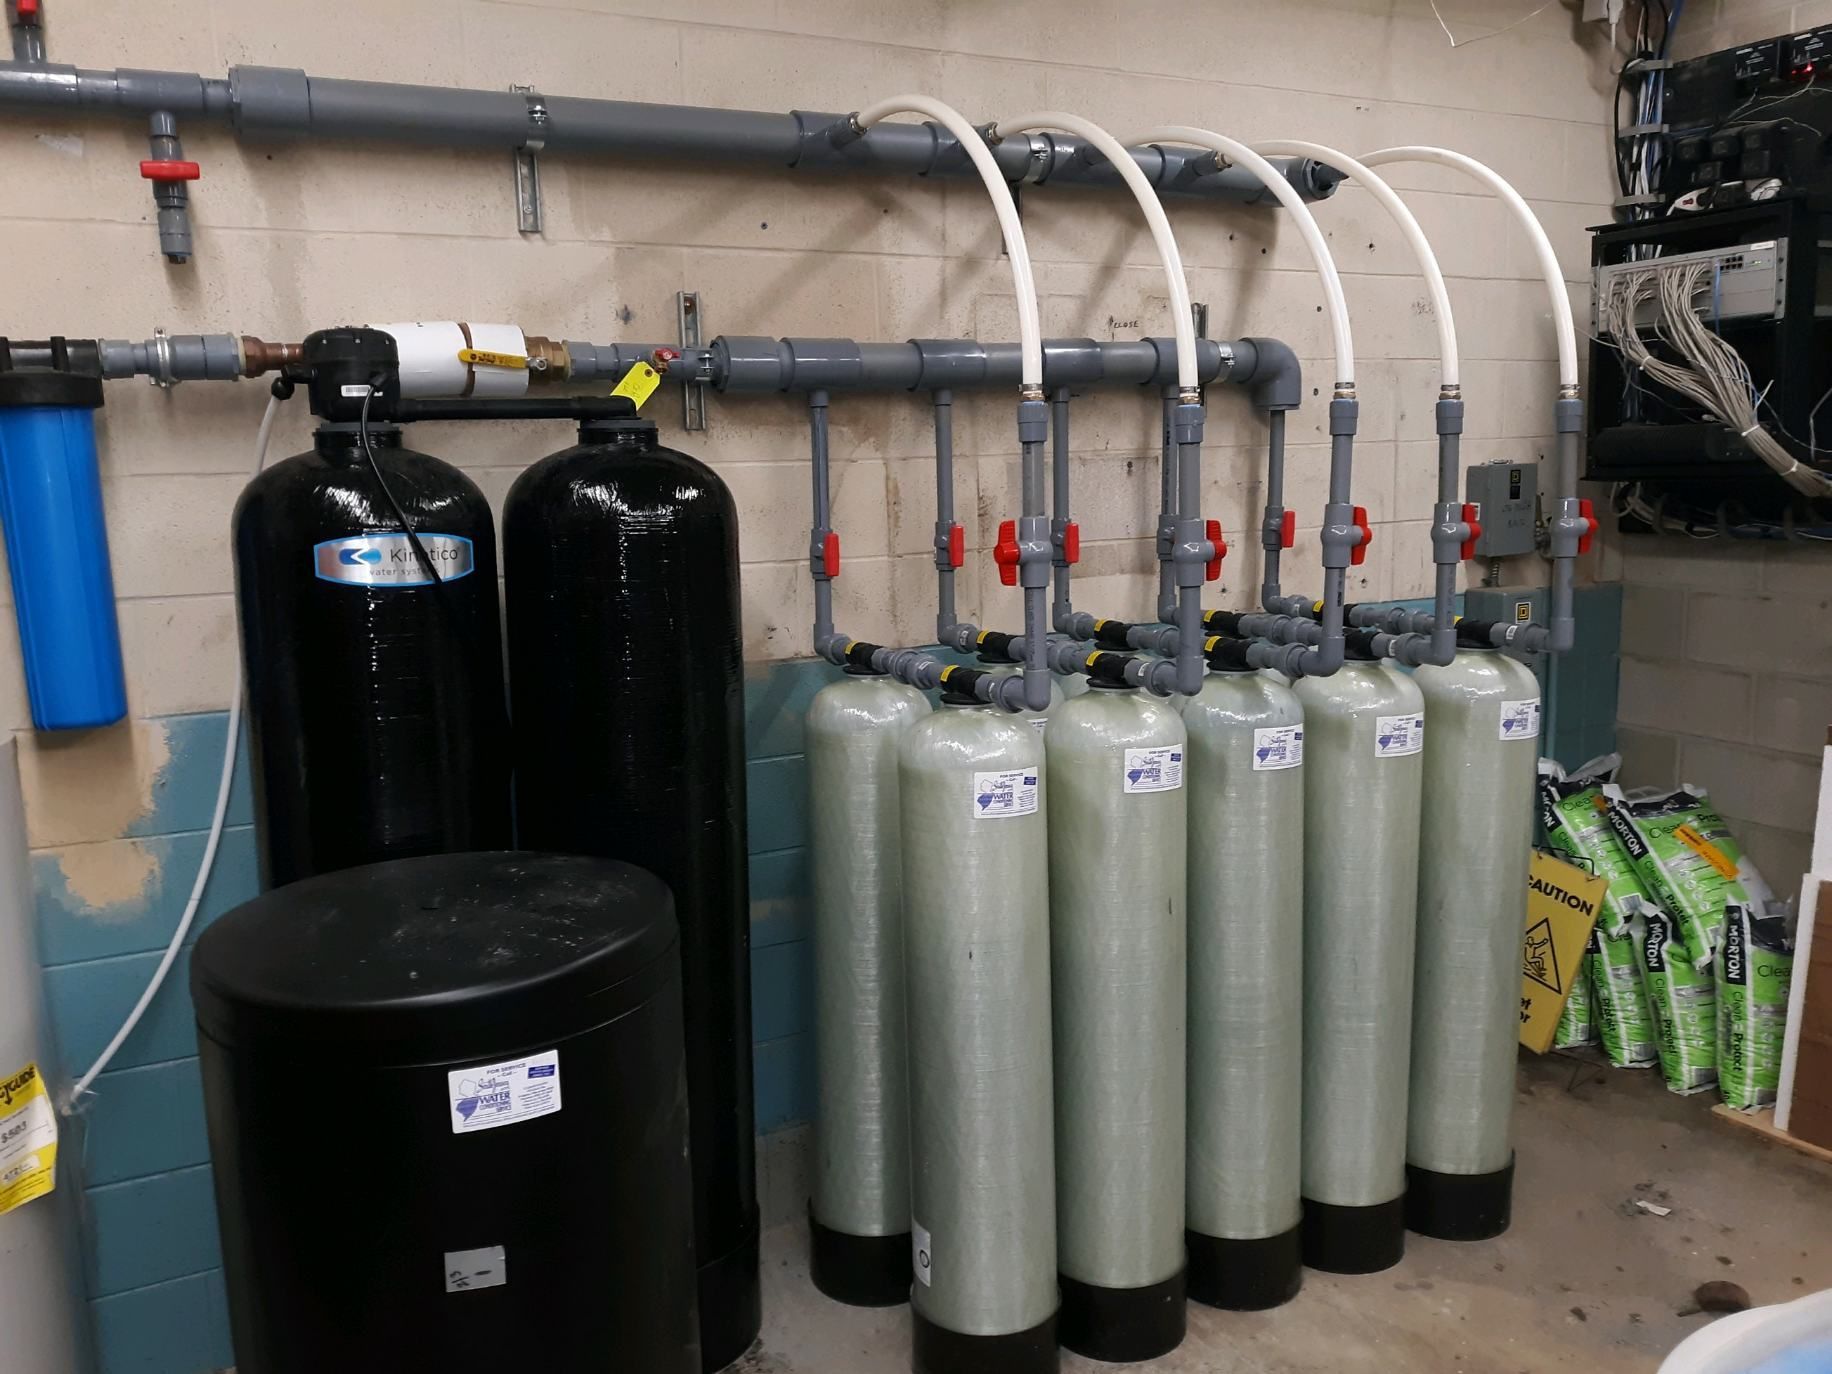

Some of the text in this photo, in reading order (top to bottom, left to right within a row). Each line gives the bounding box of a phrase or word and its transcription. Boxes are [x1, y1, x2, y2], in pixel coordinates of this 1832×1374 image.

[1114, 320, 1139, 328] CLOSE
[390, 547, 458, 562] Kintico
[1541, 791, 1556, 829] MOON
[1607, 811, 1643, 856] MORTON
[1646, 922, 1664, 967] MORTON
[1728, 924, 1741, 979] MORTON
[501, 1063, 527, 1072] SERVICE
[479, 1092, 511, 1105] WATER
